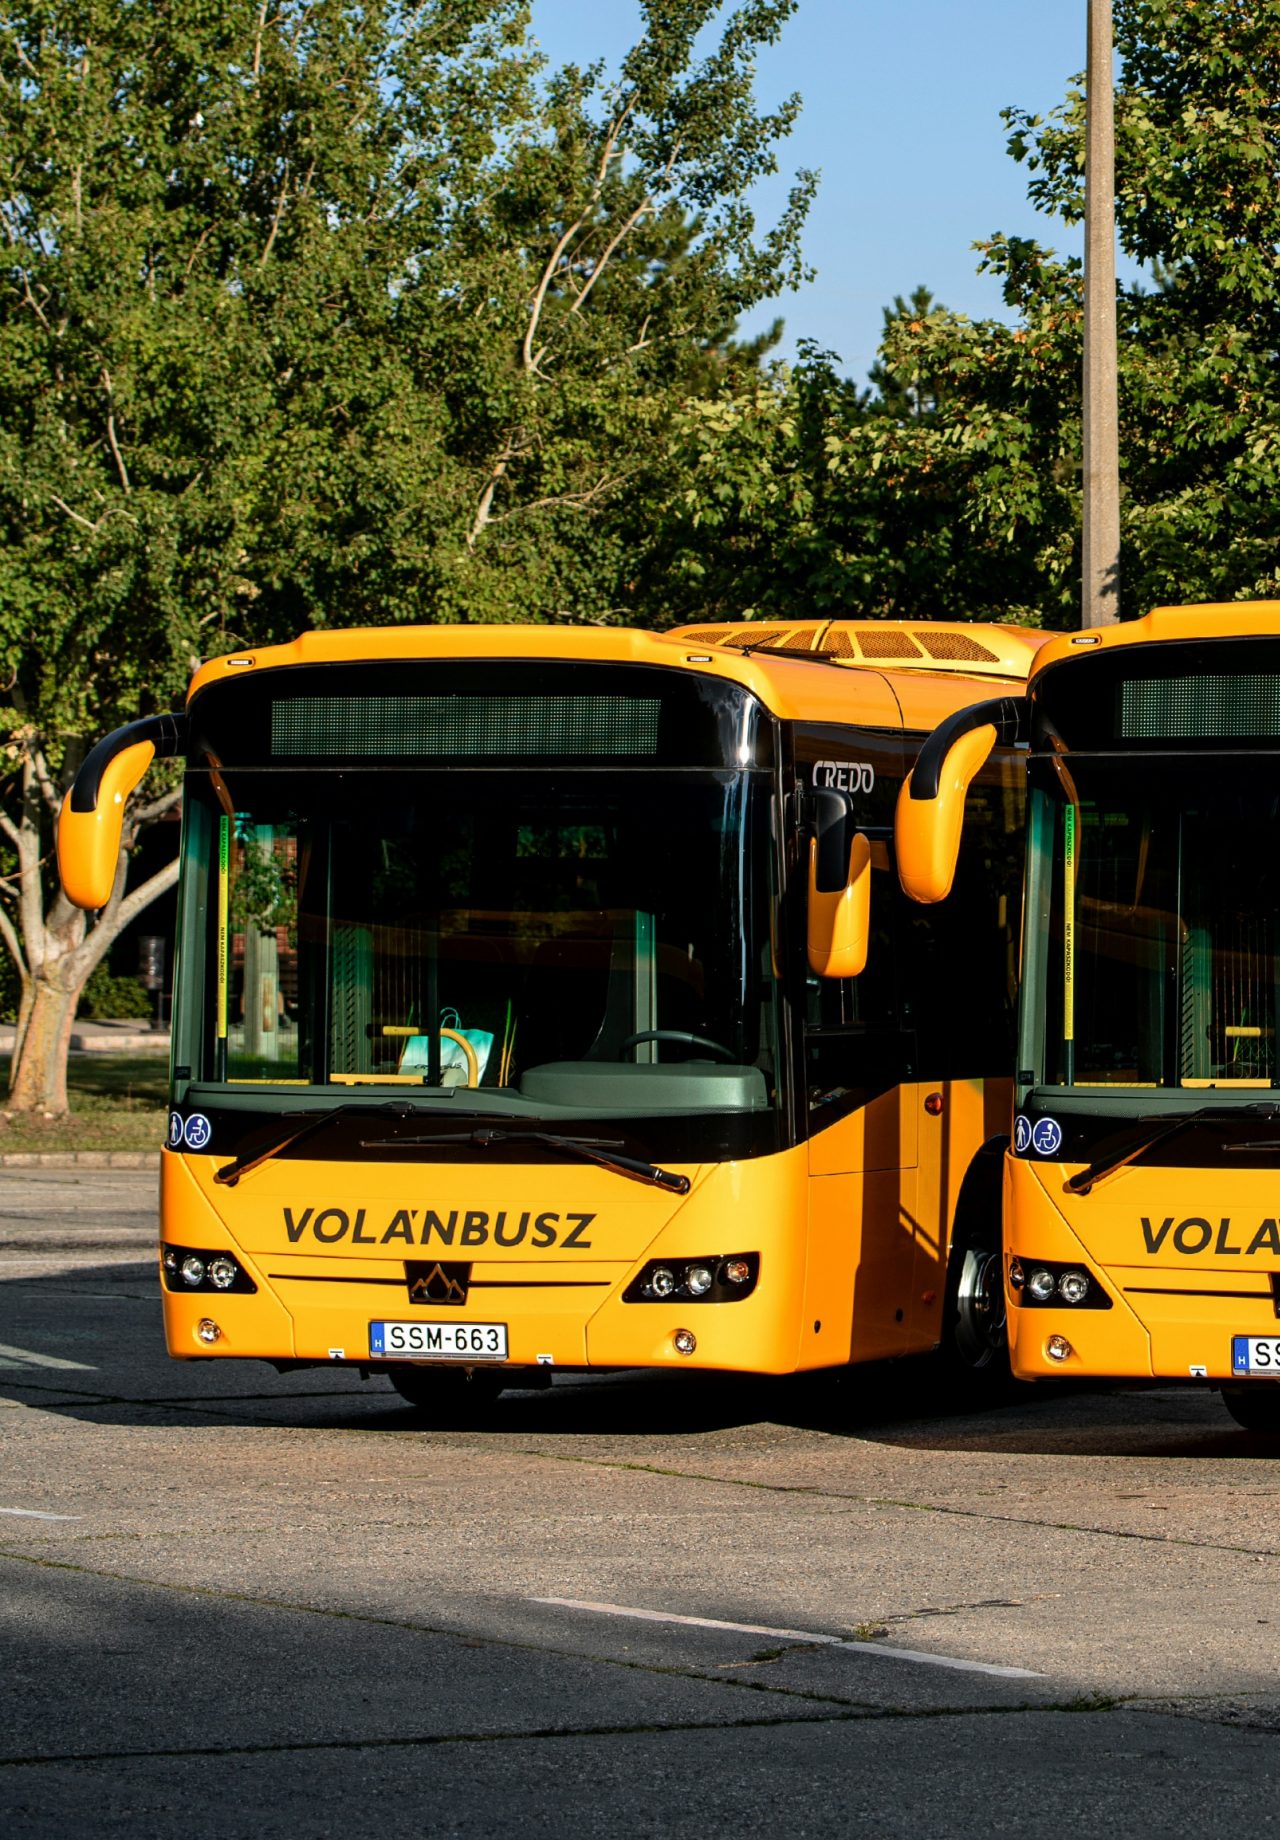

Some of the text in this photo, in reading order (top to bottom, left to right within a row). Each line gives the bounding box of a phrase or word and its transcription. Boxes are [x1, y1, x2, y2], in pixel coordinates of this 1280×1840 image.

[812, 760, 874, 793] CREDO
[283, 1207, 597, 1249] VOLÁNBUSZ
[374, 1326, 499, 1351] H SSM-663
[1238, 1356, 1246, 1365] H
